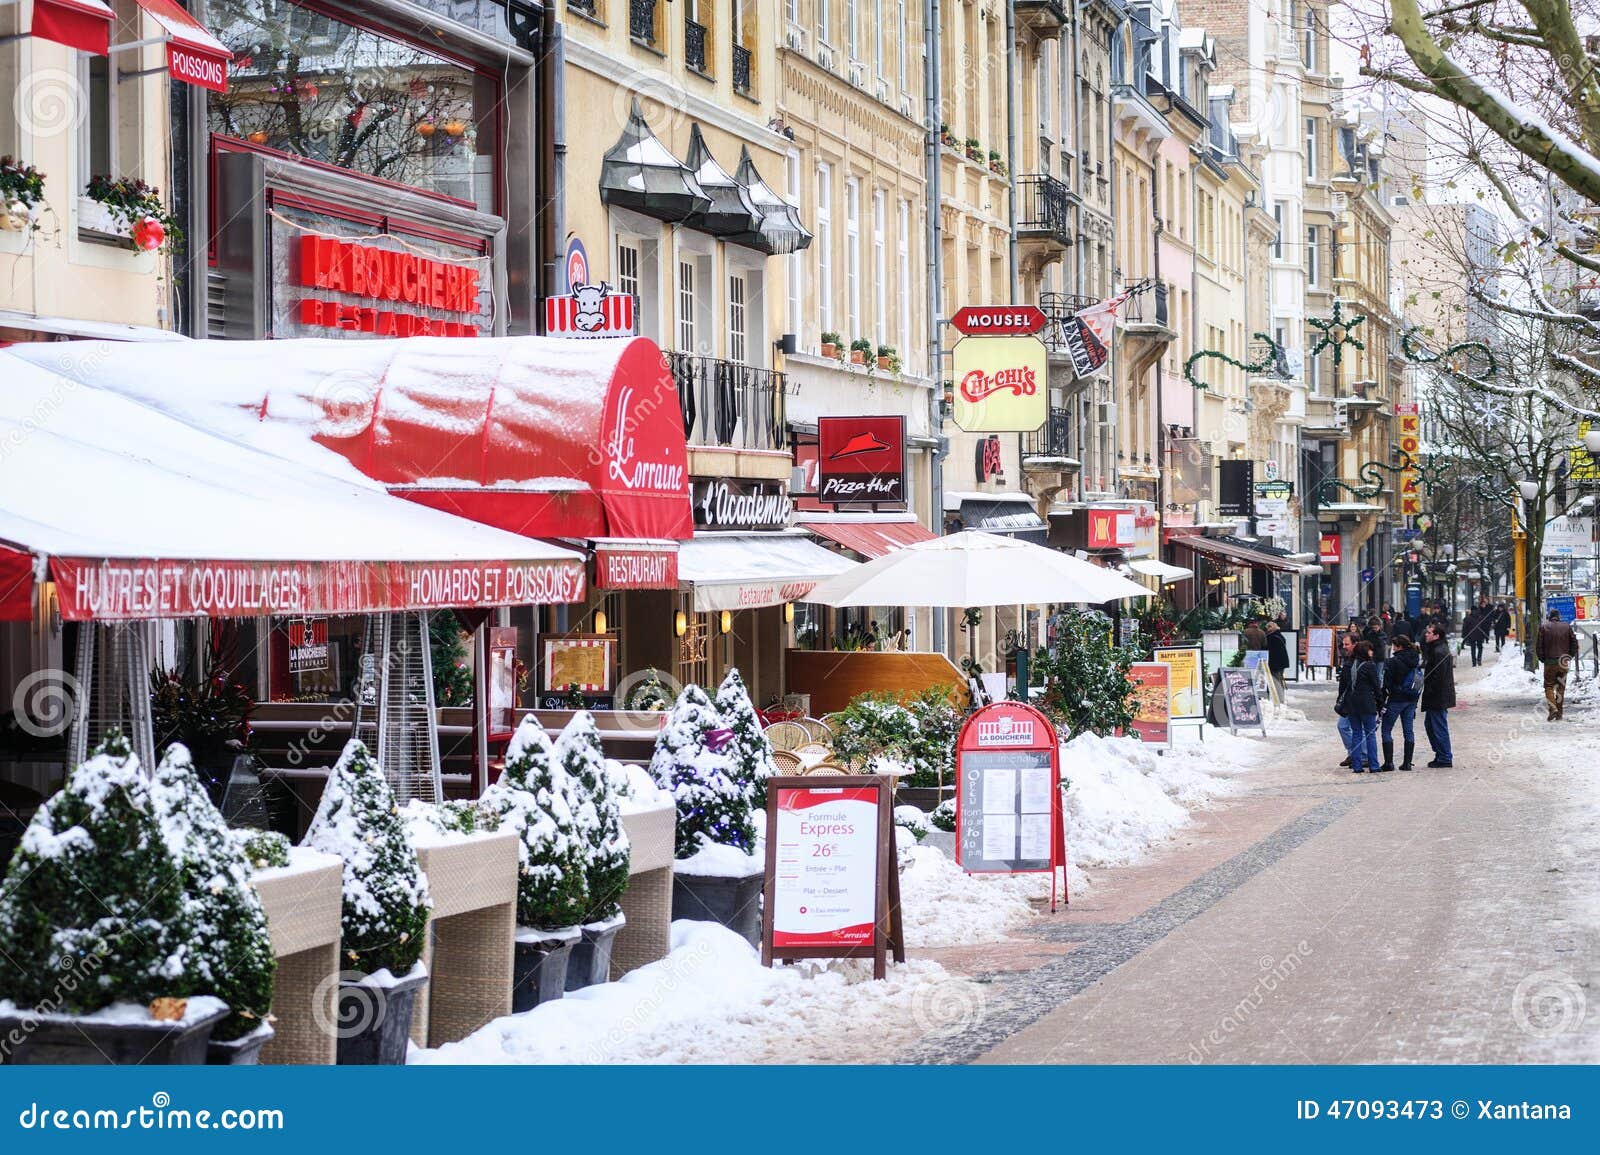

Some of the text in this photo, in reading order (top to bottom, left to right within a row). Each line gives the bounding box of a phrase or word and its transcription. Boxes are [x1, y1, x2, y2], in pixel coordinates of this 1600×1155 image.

[173, 51, 222, 84] POISSONS
[302, 235, 480, 313] LA BOUCHERIE
[967, 315, 1031, 327] MOUSEL
[960, 365, 1037, 403] CHI-CHI'S
[608, 386, 634, 464] La
[609, 448, 683, 491] Lorraine
[823, 477, 899, 495] Pizza Hut
[702, 480, 792, 525] l'Académie
[411, 565, 572, 603] HOMARDS ET POISSONS
[609, 555, 668, 583] RESTAURANT
[161, 567, 183, 609] ET
[191, 567, 299, 610] COQUILLAGES
[800, 822, 855, 837] Express
[808, 812, 847, 821] Formule
